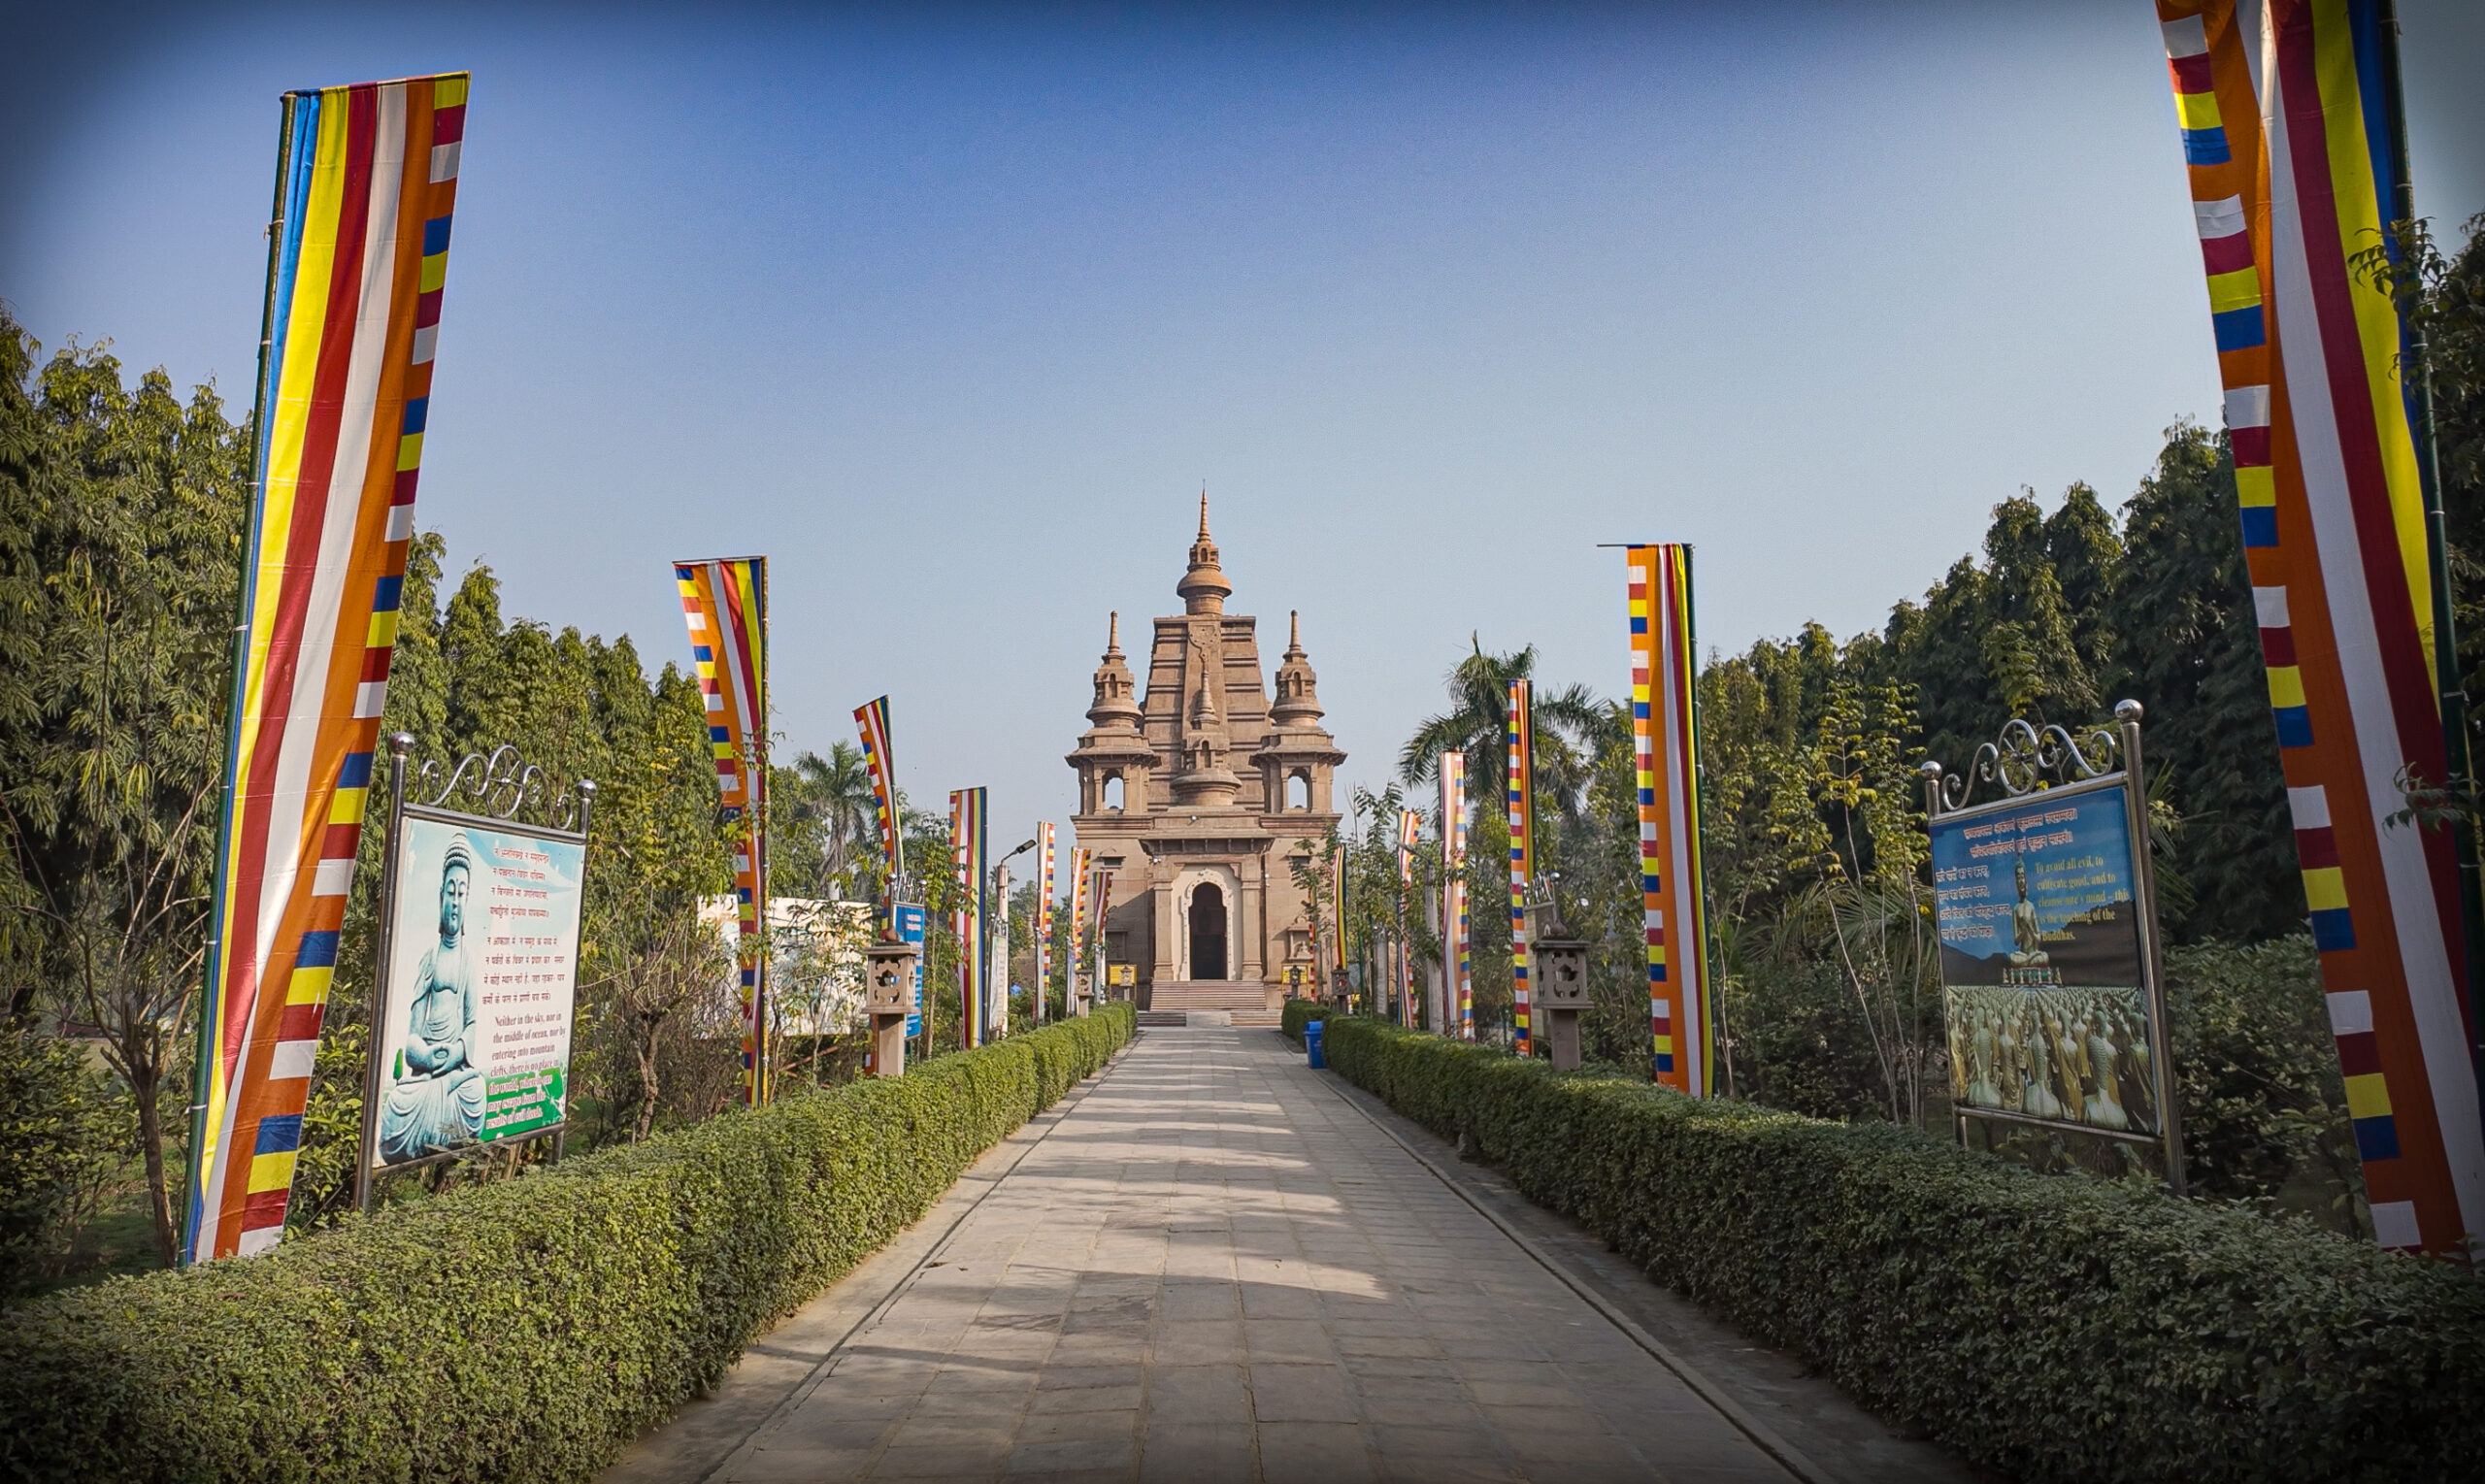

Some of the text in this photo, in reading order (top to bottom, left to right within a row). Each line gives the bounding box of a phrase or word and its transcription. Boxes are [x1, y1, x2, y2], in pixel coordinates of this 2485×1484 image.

[2036, 862, 2044, 874] To
[2045, 859, 2066, 873] avoid
[2067, 857, 2076, 870] all
[2095, 856, 2104, 866] to
[2037, 878, 2068, 891] cultivate
[2091, 872, 2106, 885] and
[2107, 873, 2116, 883] to
[2038, 896, 2064, 907] cleanse
[2085, 890, 2105, 904] mind
[2114, 888, 2130, 902] this
[2046, 913, 2058, 924] the
[2059, 910, 2093, 925] teaching
[2092, 909, 2101, 921] of
[2102, 907, 2116, 921] the
[2041, 930, 2076, 941] Buddhas.
[495, 1015, 517, 1027] Neither
[517, 1014, 523, 1025] in
[524, 1013, 533, 1024] the
[535, 1012, 546, 1024] sky,
[556, 1012, 561, 1021] in
[493, 1032, 503, 1043] the
[504, 1030, 524, 1042] middle
[524, 1029, 532, 1039] of
[559, 1025, 566, 1039] by
[492, 1043, 555, 1061] entering into mountain
[509, 1063, 524, 1074] there
[489, 1082, 500, 1095] the
[502, 1097, 522, 1110] escape
